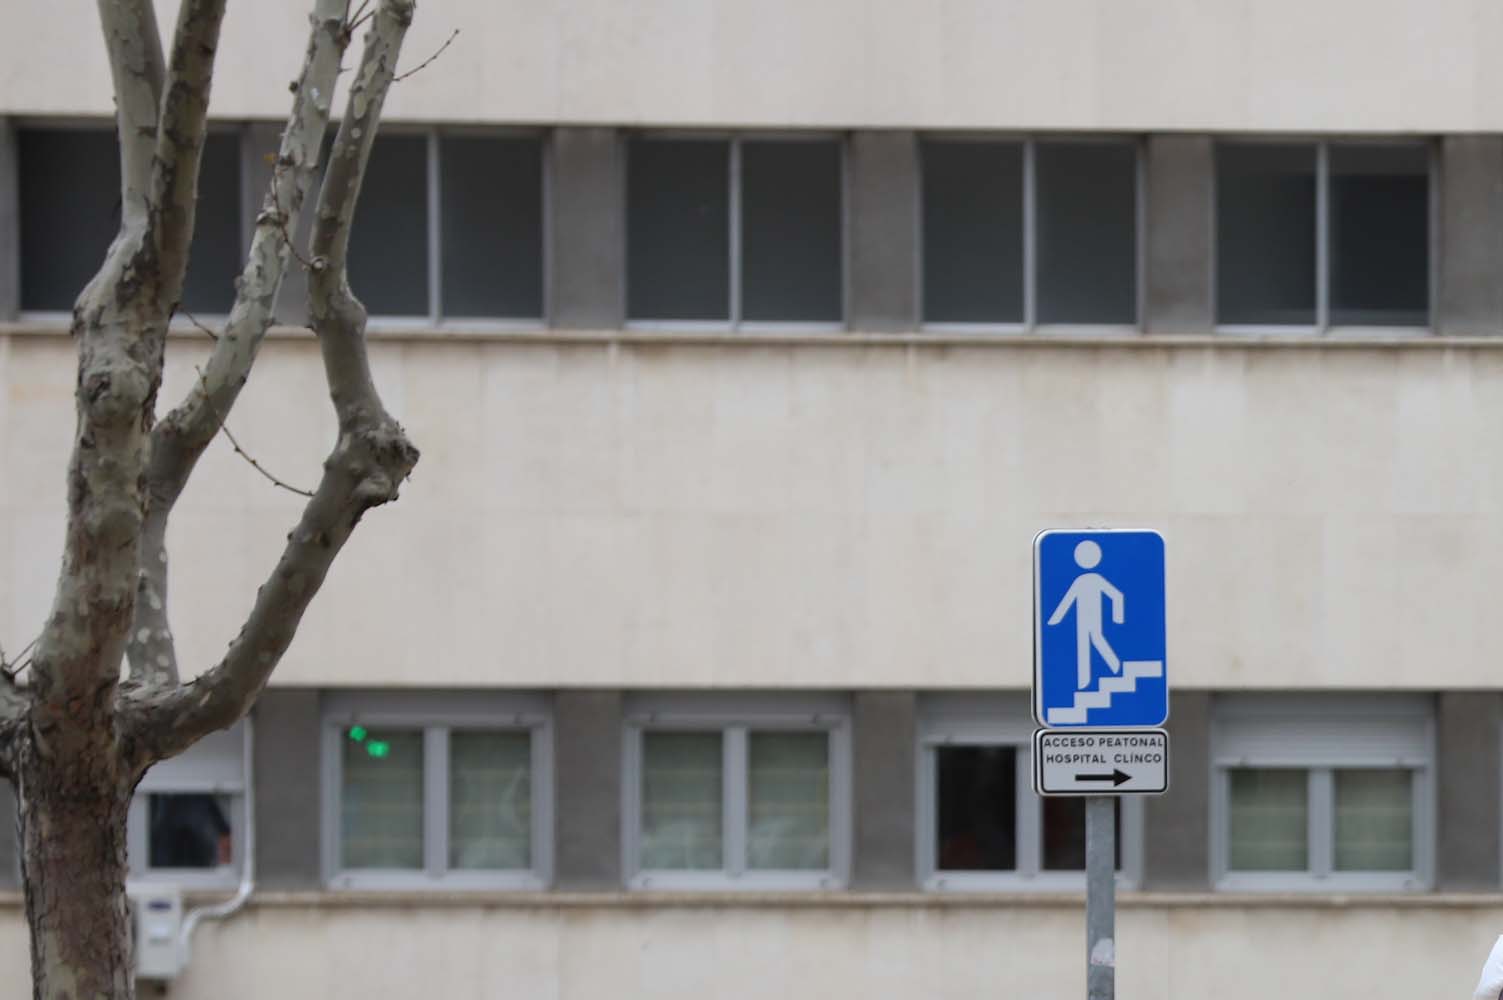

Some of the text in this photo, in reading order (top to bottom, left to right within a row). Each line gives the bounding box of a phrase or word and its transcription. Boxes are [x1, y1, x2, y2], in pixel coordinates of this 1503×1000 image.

[1043, 737, 1163, 747] ACCESO PEATONAL
[1046, 754, 1107, 763] HOSPITAL
